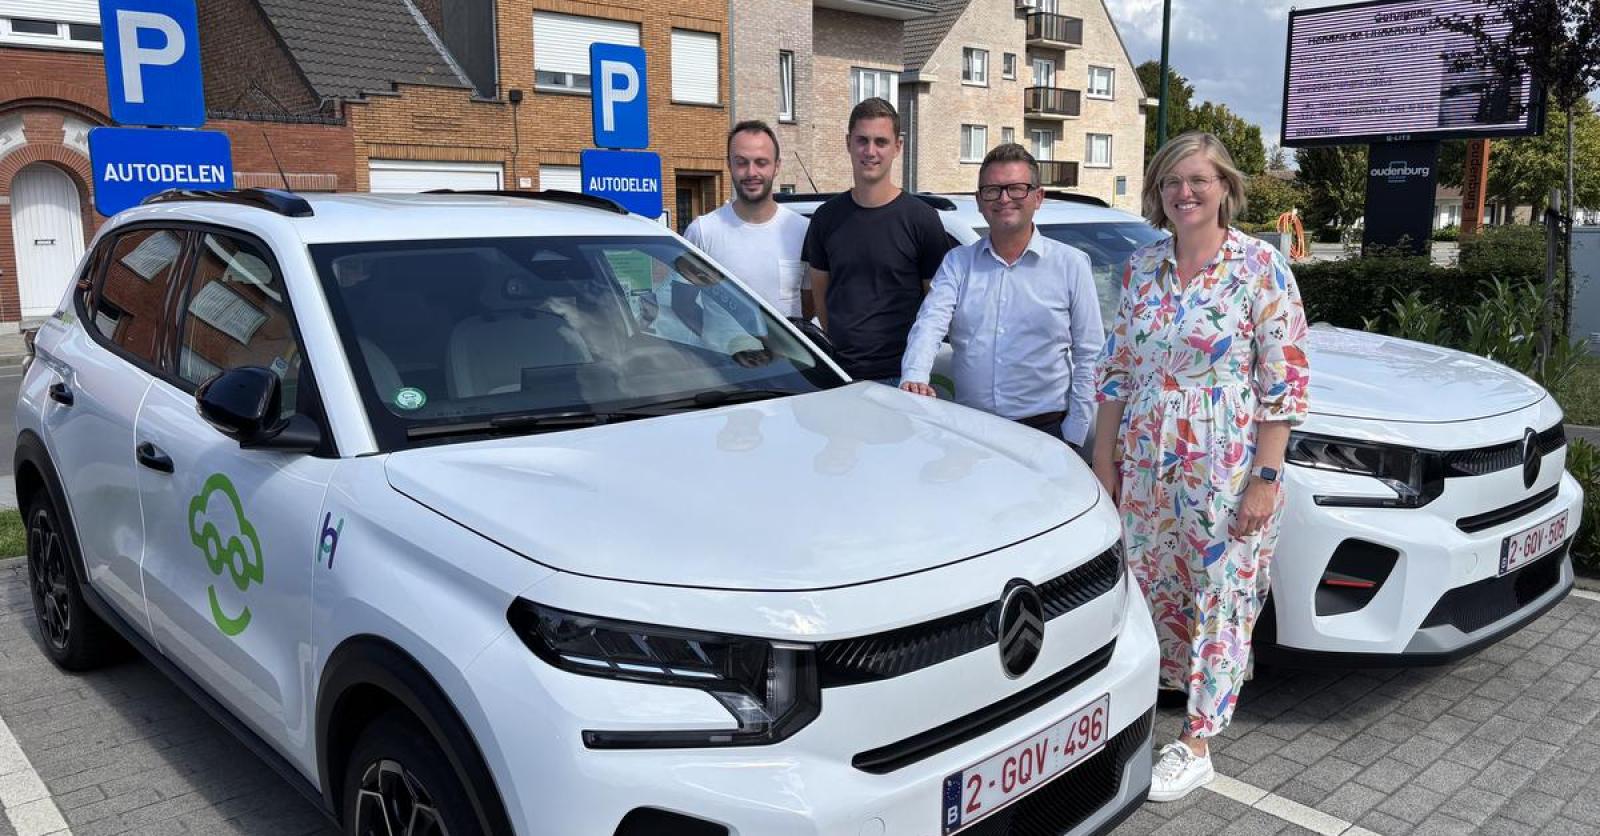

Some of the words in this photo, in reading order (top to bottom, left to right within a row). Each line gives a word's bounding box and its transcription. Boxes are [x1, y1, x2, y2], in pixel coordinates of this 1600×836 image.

[116, 9, 185, 103] P
[601, 60, 639, 131] P
[104, 163, 225, 183] AUTODELEN
[1370, 163, 1430, 177] oudenburg
[589, 177, 657, 192] AUTODELEN
[966, 707, 1103, 814] 2-GQV-496
[947, 805, 958, 824] B
